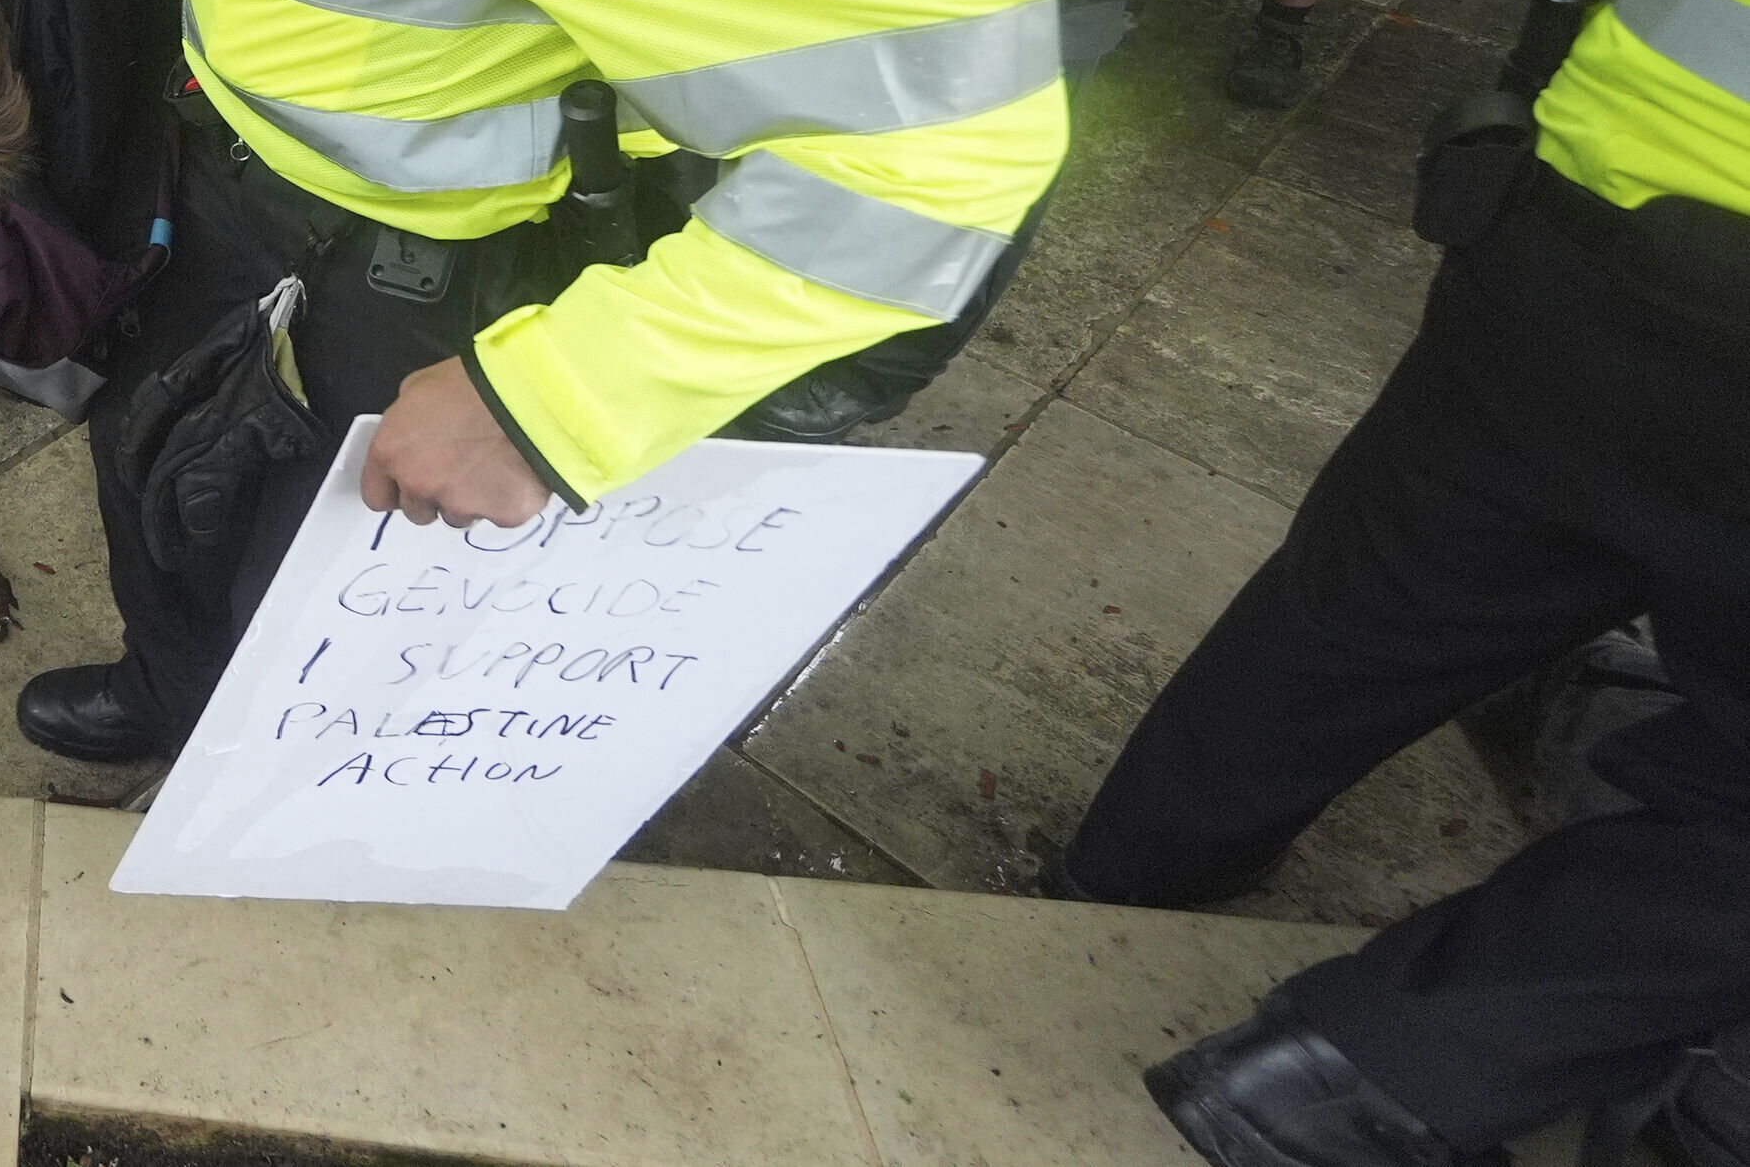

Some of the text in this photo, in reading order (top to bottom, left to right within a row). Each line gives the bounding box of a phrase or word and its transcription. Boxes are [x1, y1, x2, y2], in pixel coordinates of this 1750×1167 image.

[338, 562, 721, 616] GENOCIDE
[298, 637, 699, 691] I SUPPORT
[276, 702, 616, 745] PALESTINE
[317, 752, 563, 786] ACTION
